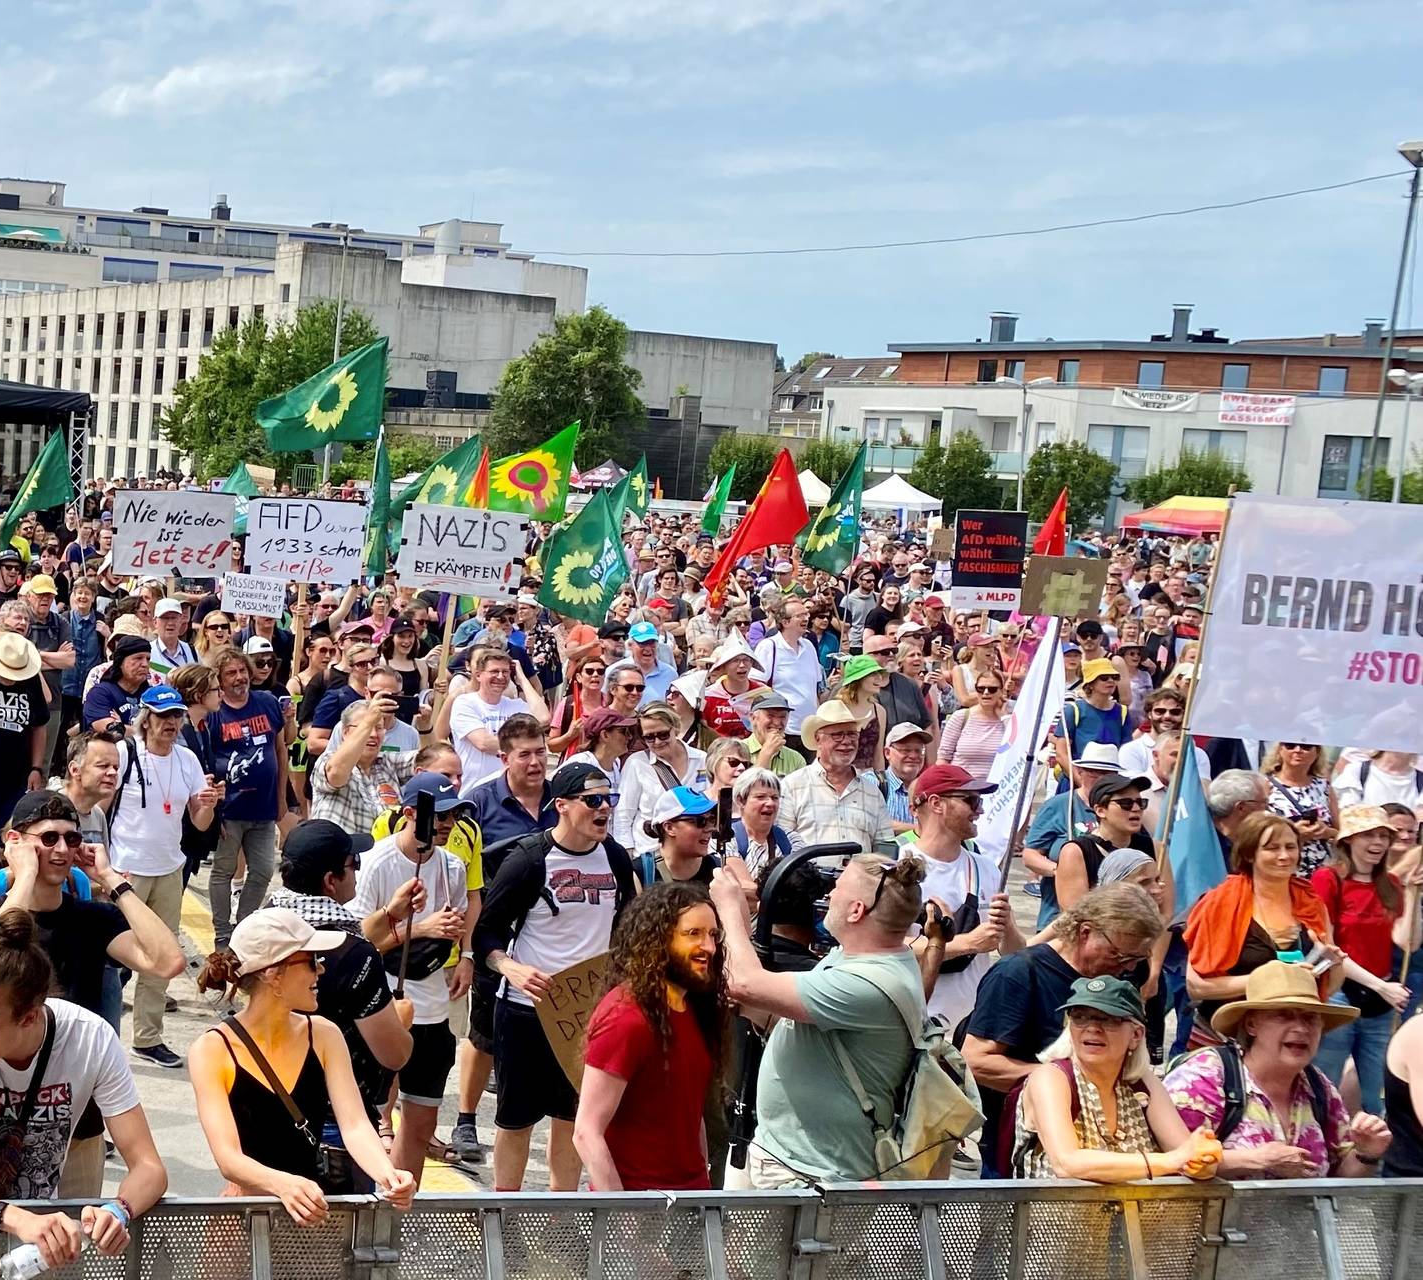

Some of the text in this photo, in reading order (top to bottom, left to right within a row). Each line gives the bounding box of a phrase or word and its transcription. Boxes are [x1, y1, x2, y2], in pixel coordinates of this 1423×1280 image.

[1138, 390, 1173, 400] WIEDER
[1140, 401, 1168, 409] JETZT
[1221, 414, 1290, 423] RASSISMUS
[123, 499, 226, 527] Nie wieder
[258, 502, 322, 533] AFD
[324, 522, 359, 534] war
[961, 520, 984, 530] Wer
[157, 528, 184, 542] ist
[961, 534, 984, 545] AfD
[131, 540, 231, 569] Jetzt!
[260, 538, 361, 558] 1933 schon
[960, 548, 993, 559] wählt
[958, 562, 1020, 574] FASCHISMUS!
[225, 575, 273, 592] RASSISMUS
[986, 592, 1016, 602] MLPD
[1241, 573, 1374, 633] BERND
[1346, 650, 1423, 686] #STO
[548, 969, 600, 1010] BRA
